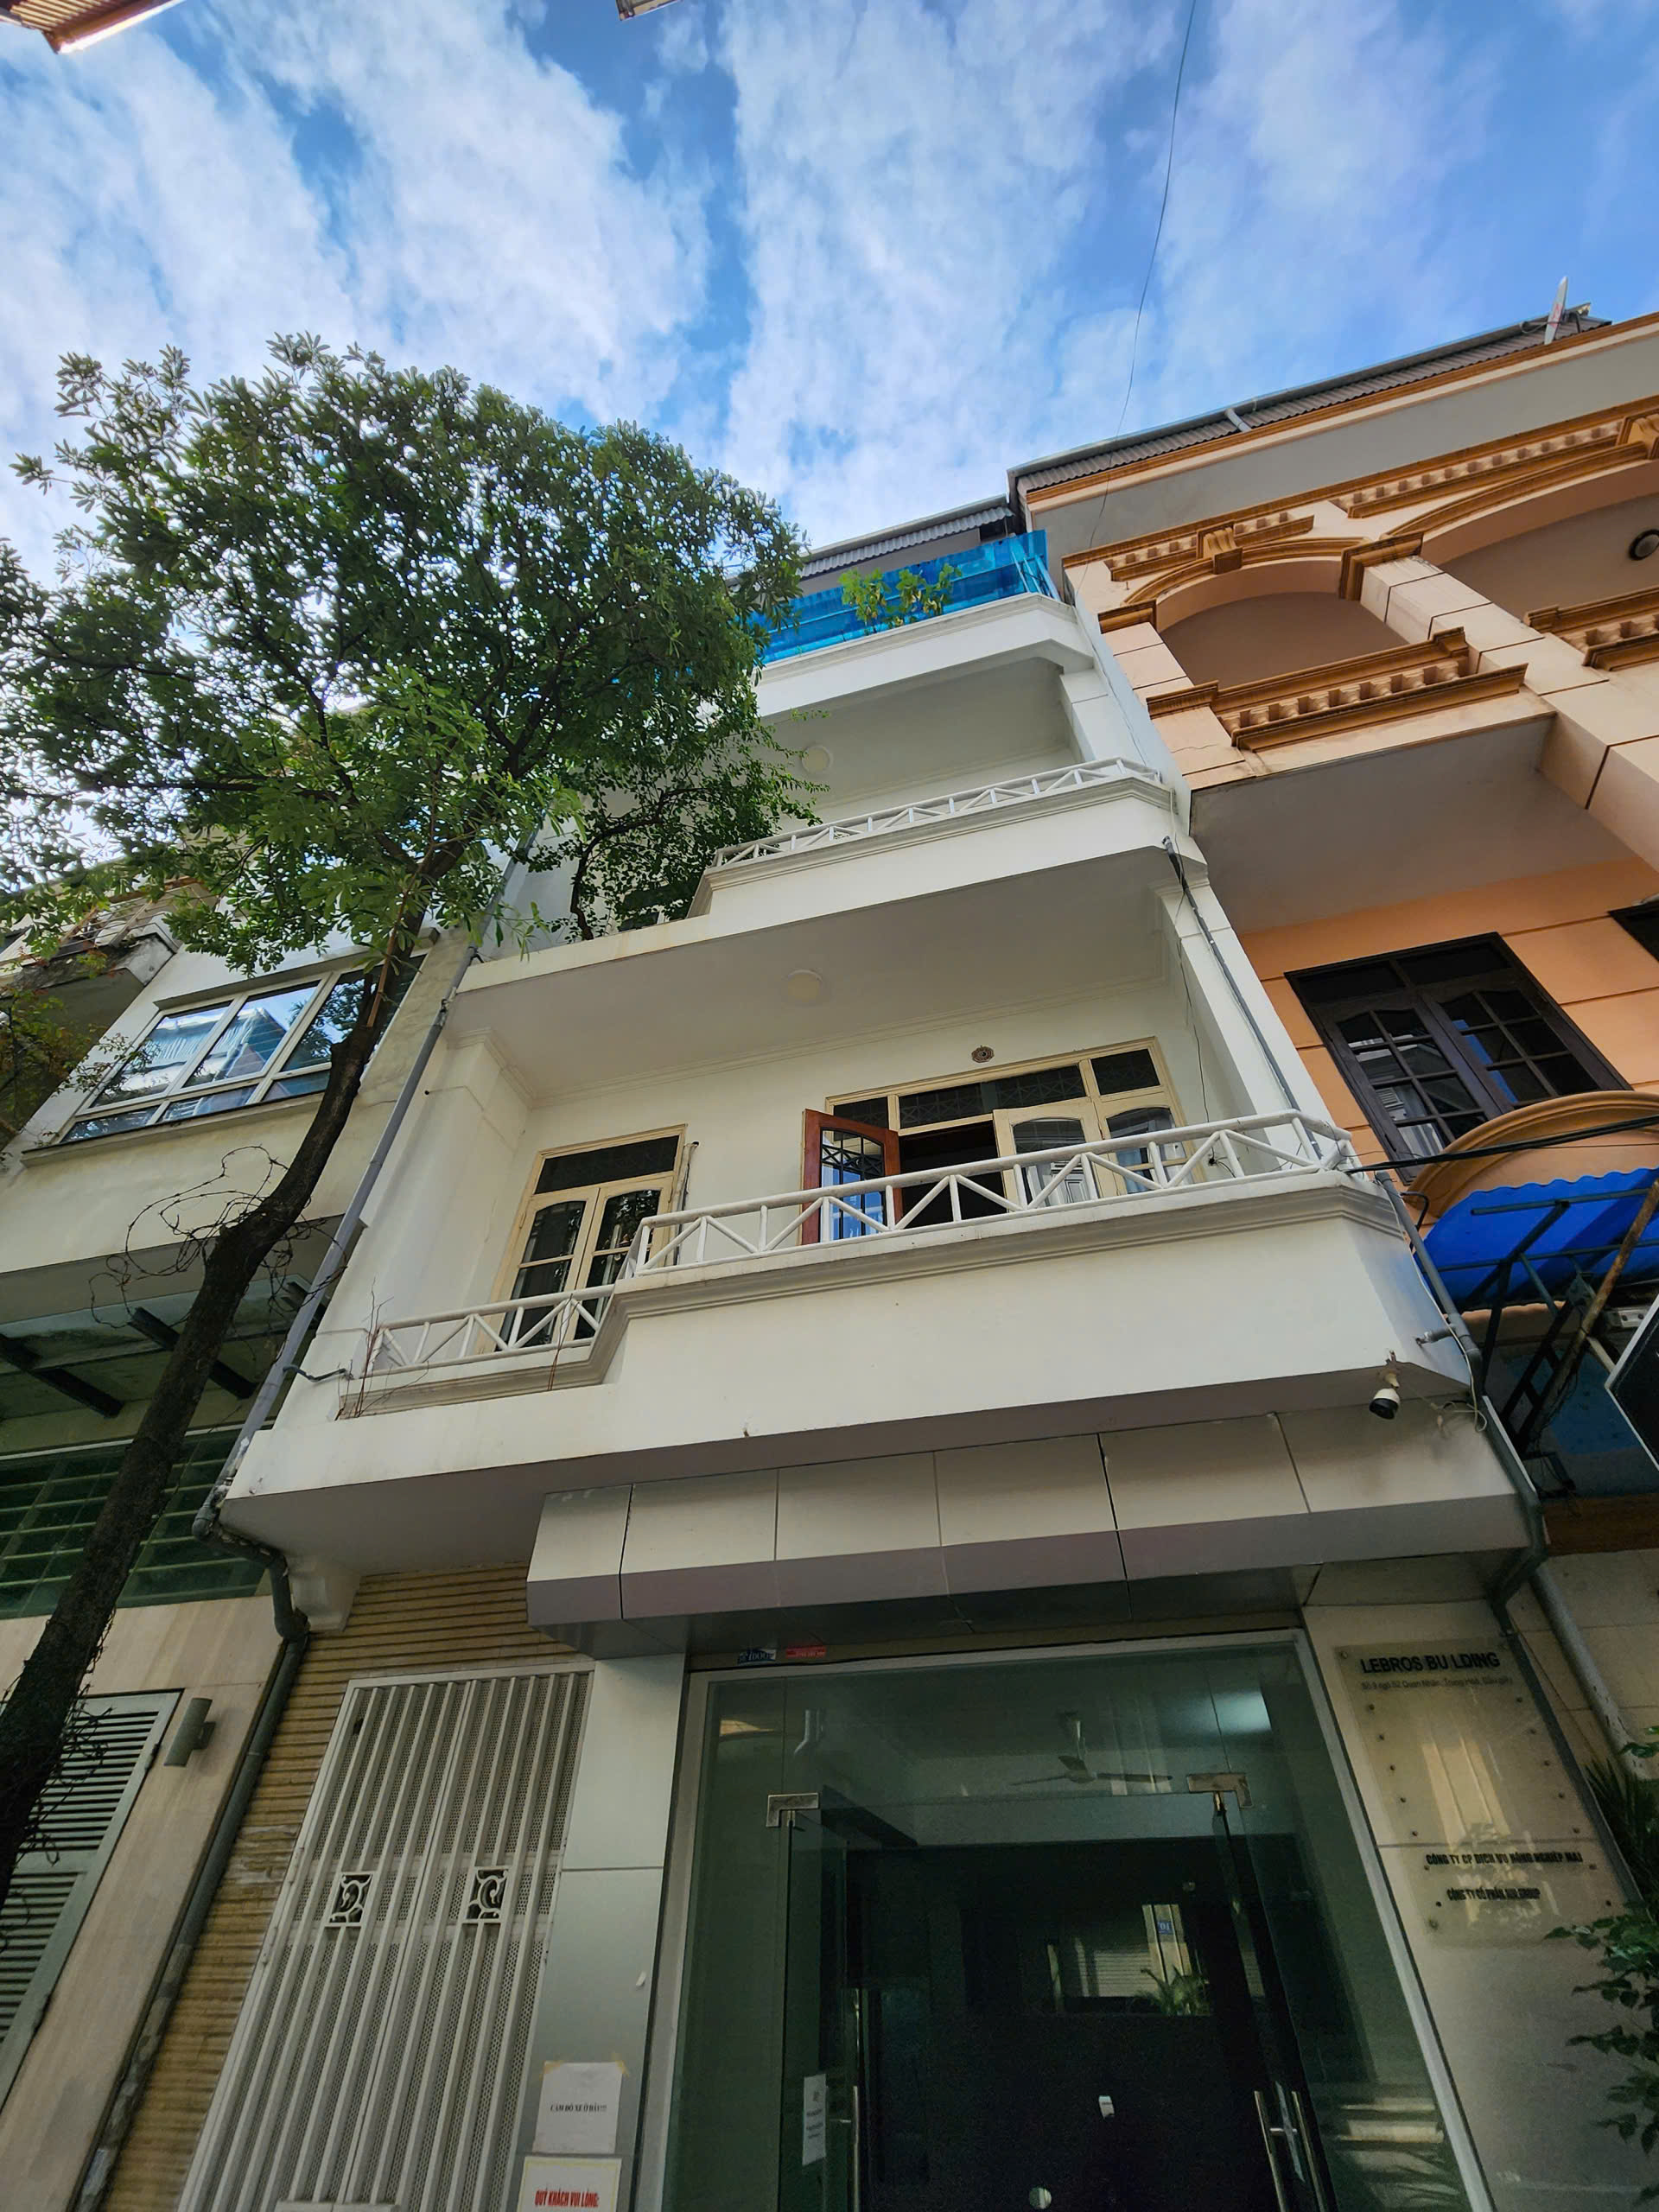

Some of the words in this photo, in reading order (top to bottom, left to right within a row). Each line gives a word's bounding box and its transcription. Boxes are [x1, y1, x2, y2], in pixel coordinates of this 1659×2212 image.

[1360, 1656, 1423, 1674] LEBROS
[1426, 1853, 1449, 1865] CÔNG
[1450, 1854, 1459, 1864] TY
[1461, 1853, 1471, 1864] CP
[1465, 1889, 1476, 1899] TY
[535, 2188, 548, 2206] QUÝ
[548, 2188, 569, 2207] KHÁCH
[570, 2191, 581, 2208] VUI
